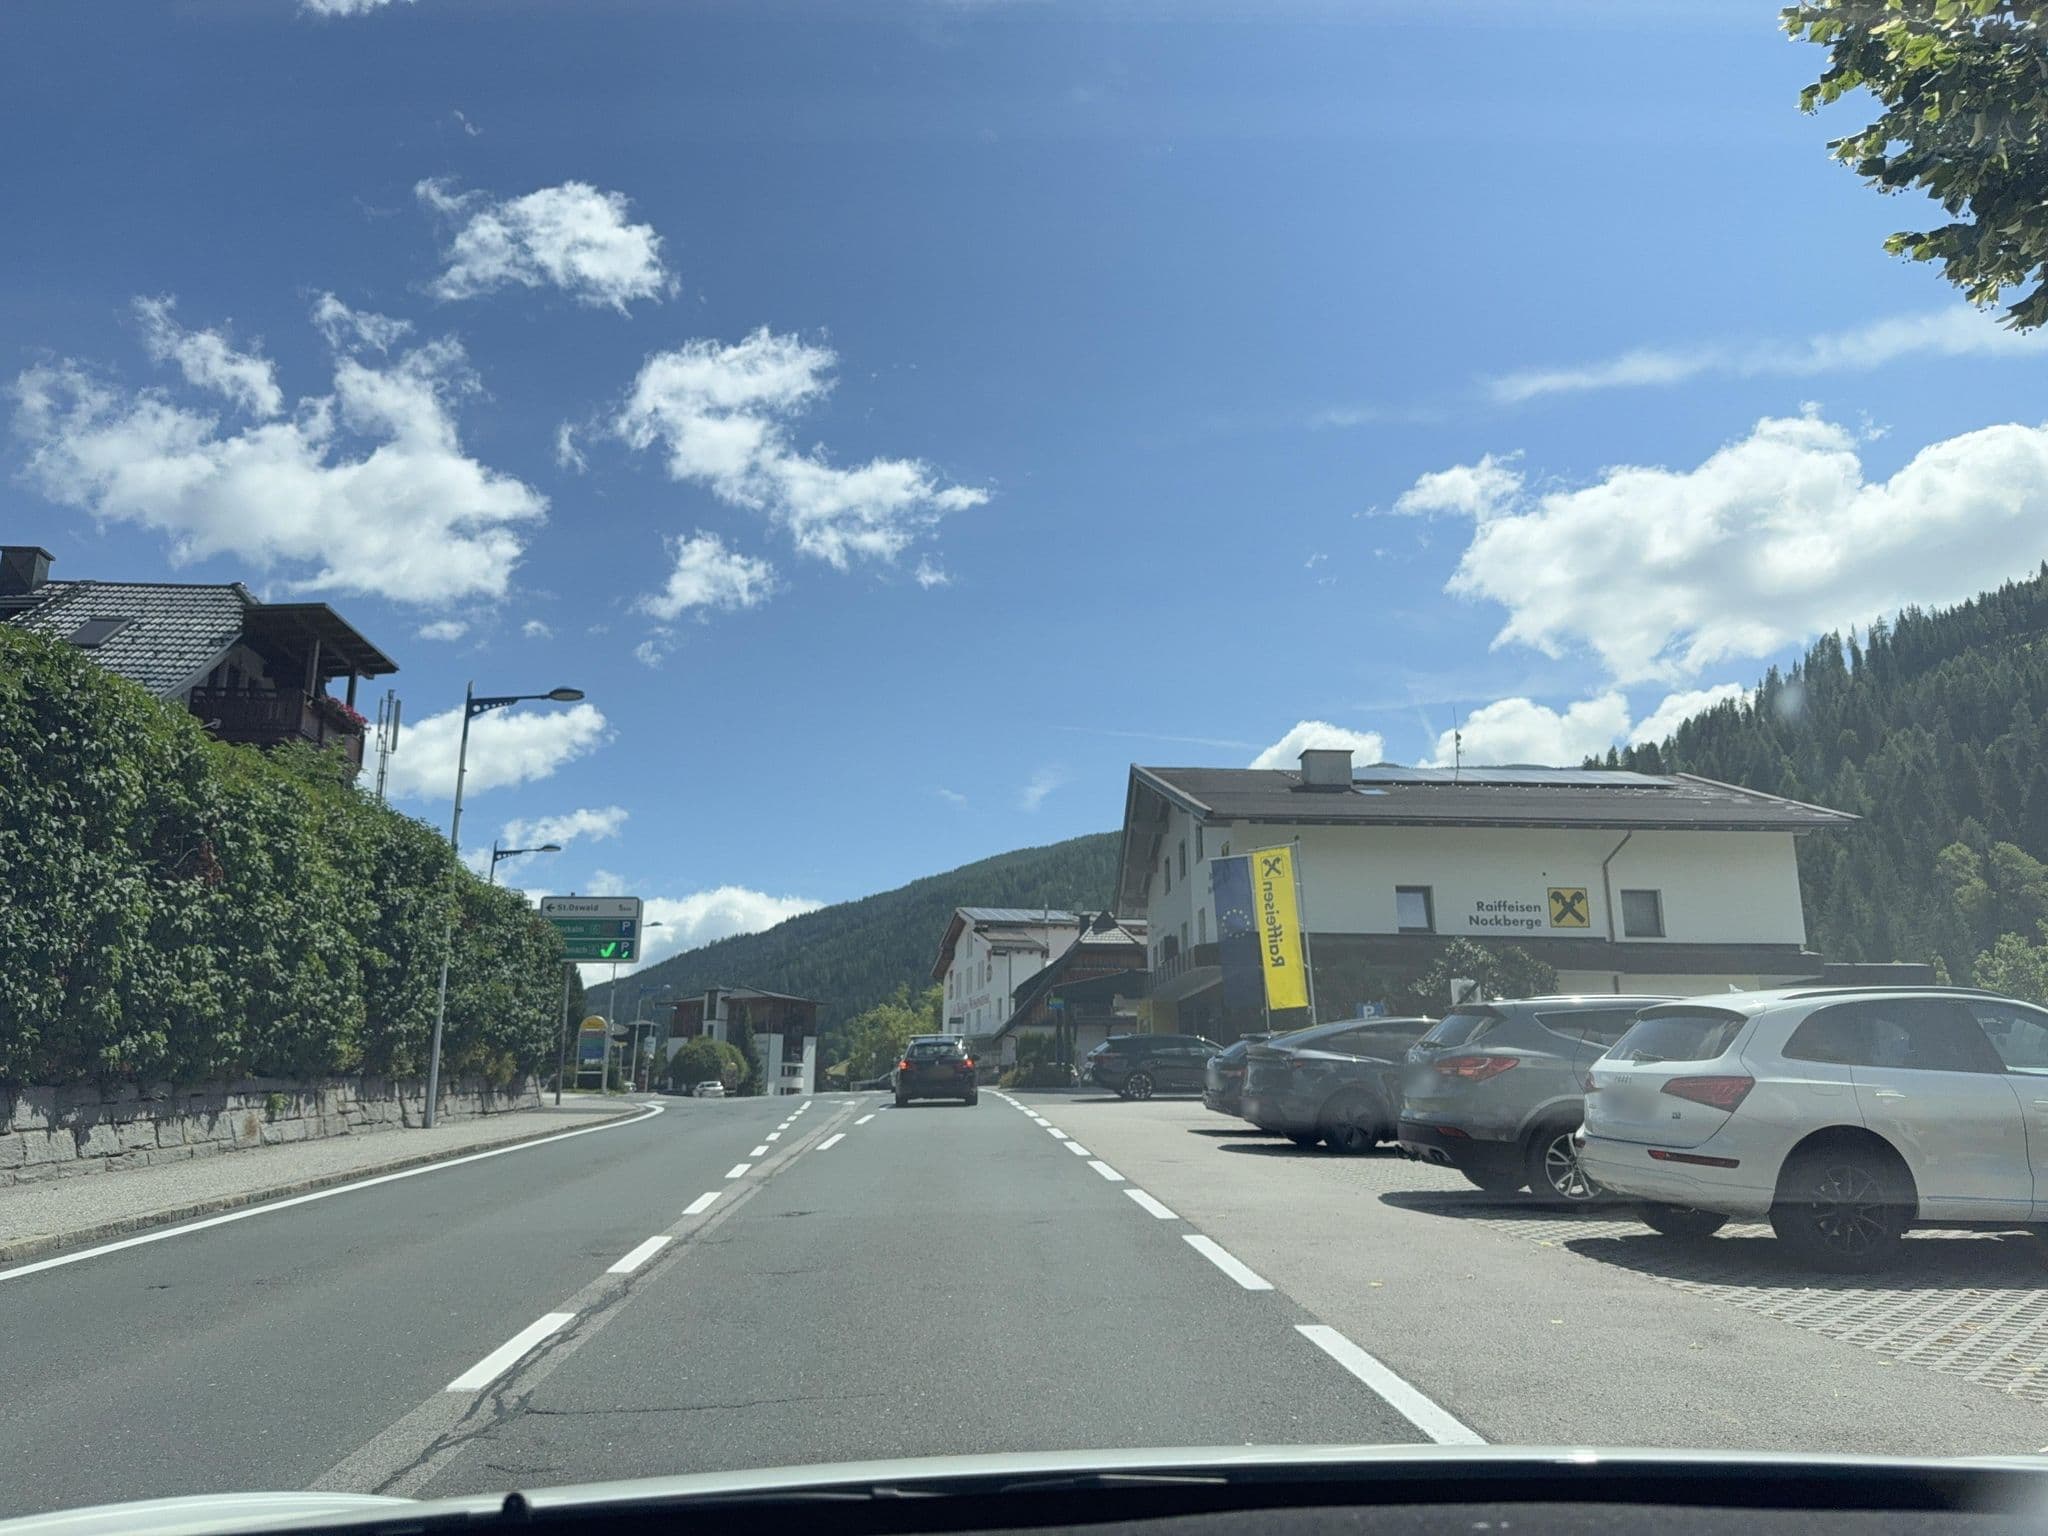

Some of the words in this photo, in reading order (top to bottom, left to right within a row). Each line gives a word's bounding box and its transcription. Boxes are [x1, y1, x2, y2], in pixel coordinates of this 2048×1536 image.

[1476, 901, 1541, 912] Raiffeisen
[622, 921, 631, 931] P
[1469, 915, 1542, 929] Nockberge
[1363, 1005, 1375, 1020] P
